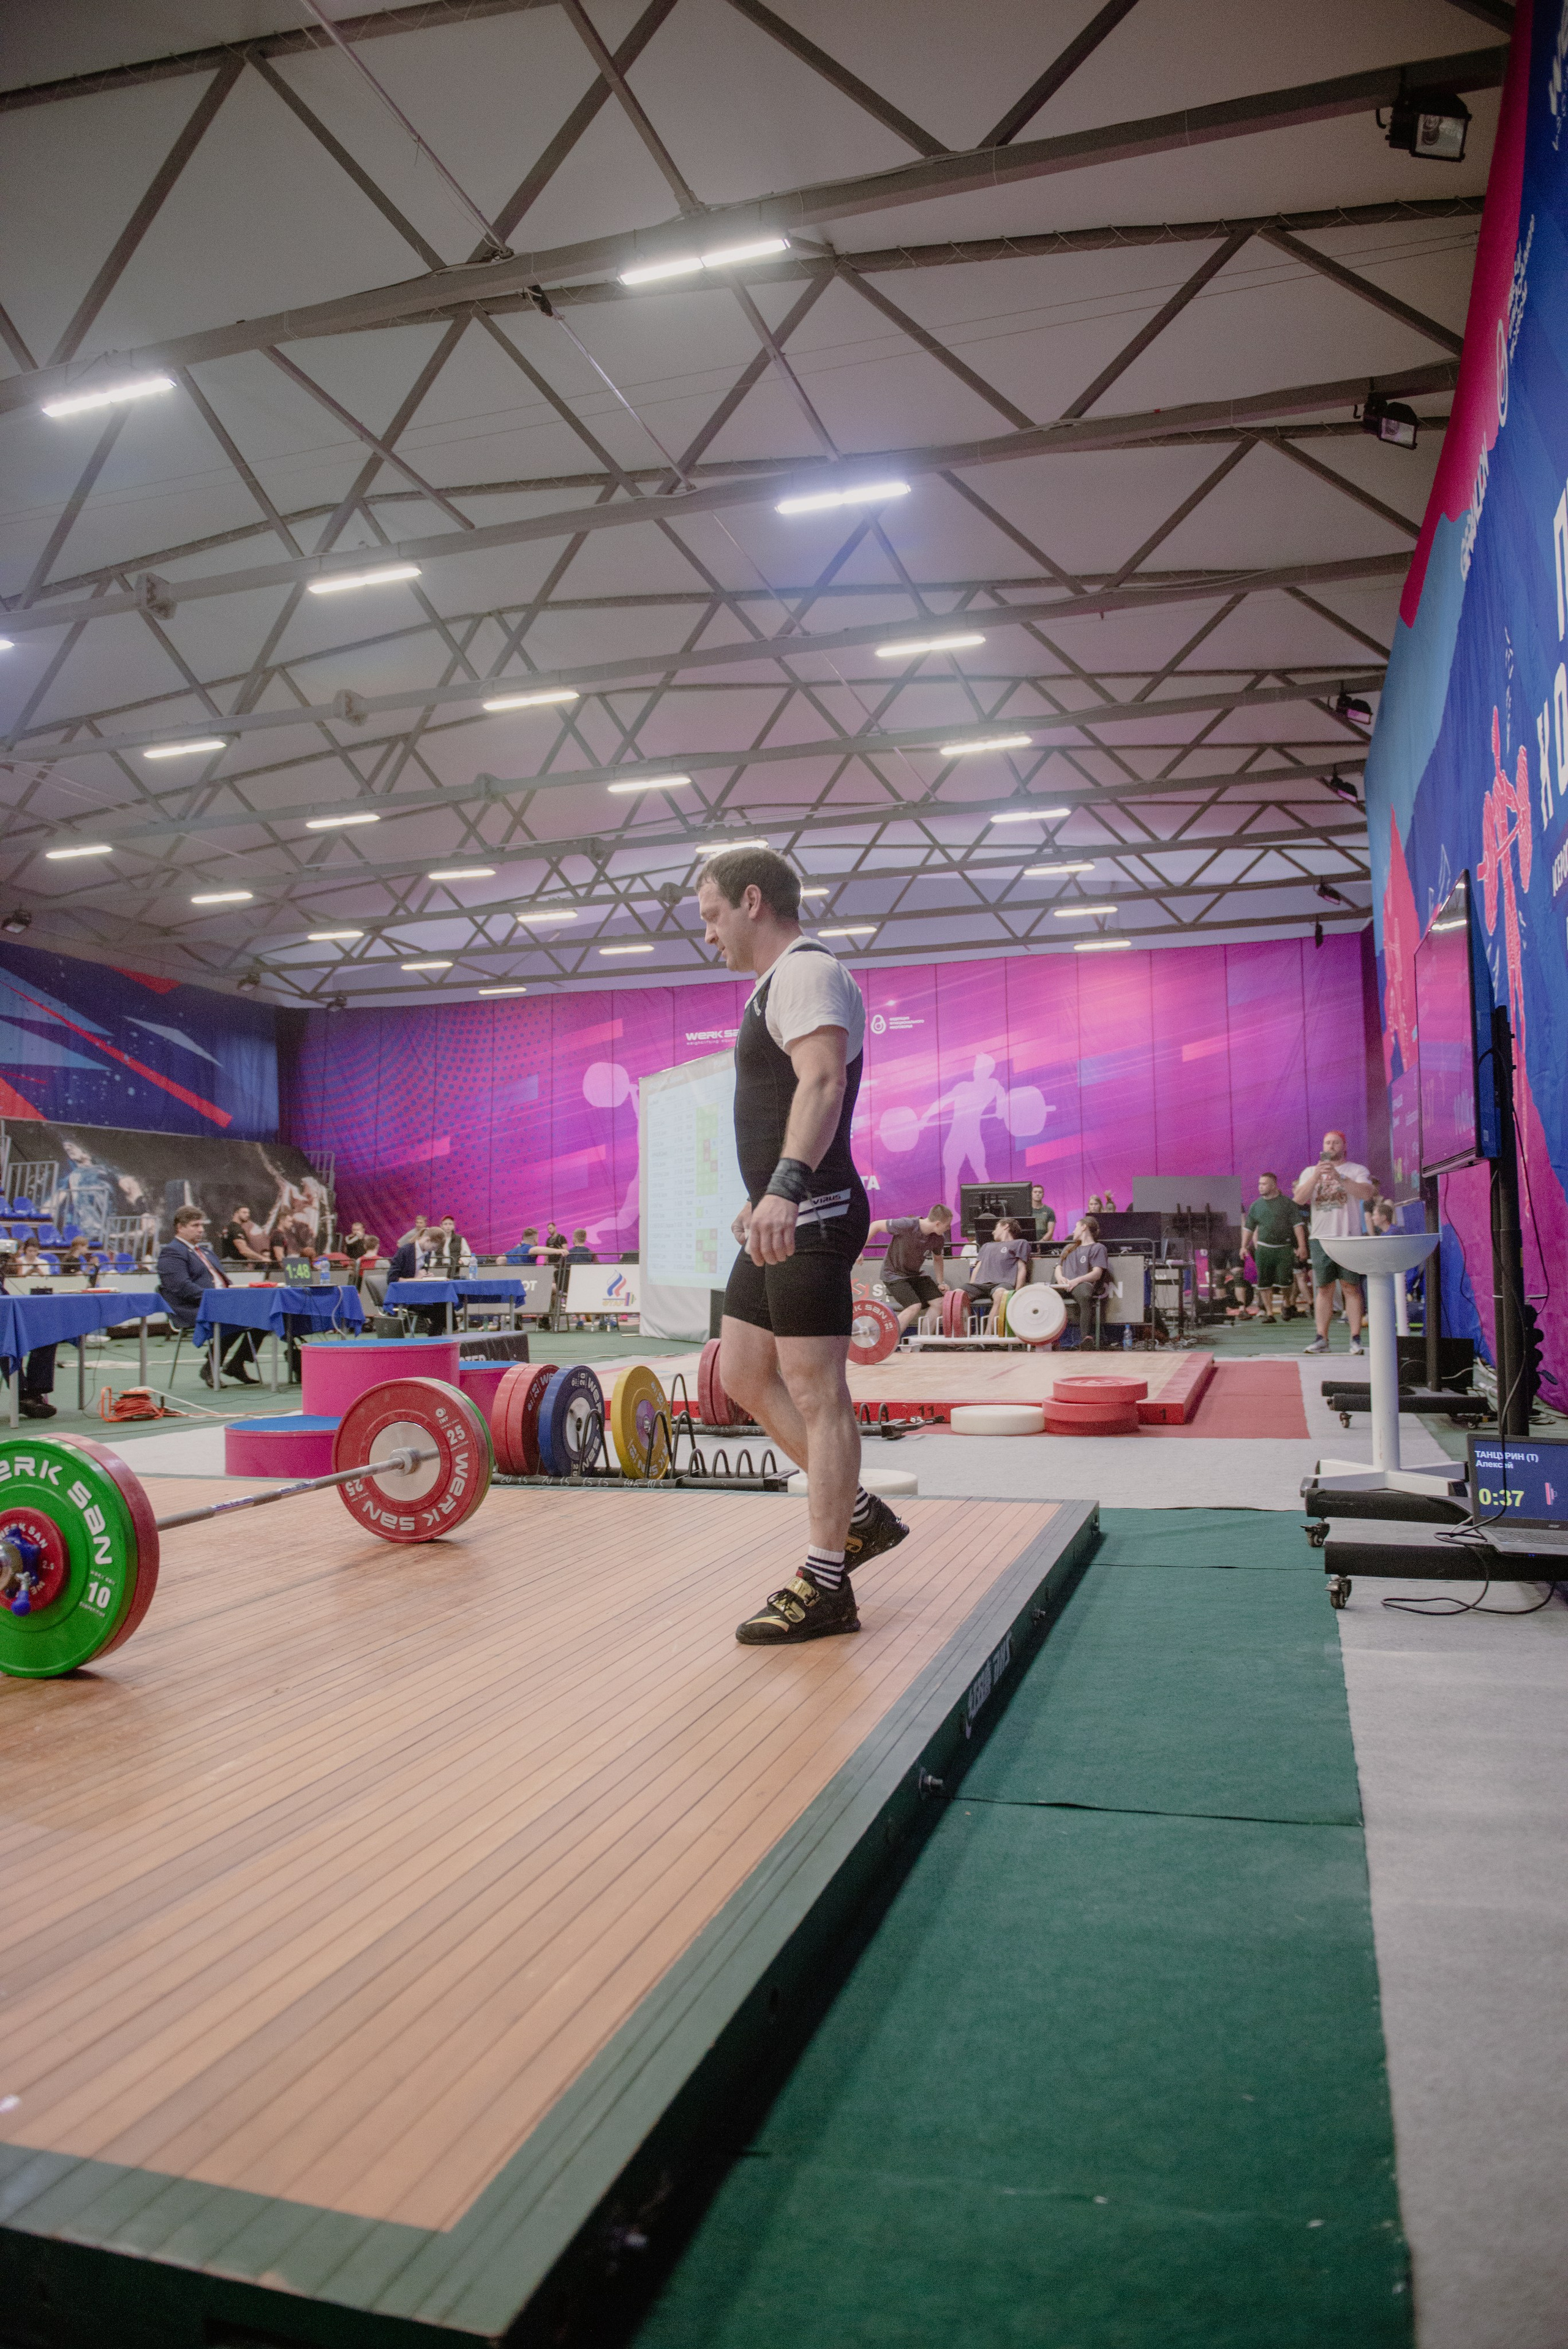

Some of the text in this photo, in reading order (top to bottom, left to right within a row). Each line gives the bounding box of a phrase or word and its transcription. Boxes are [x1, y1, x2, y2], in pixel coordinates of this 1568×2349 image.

[285, 1264, 311, 1279] 1:48
[447, 1425, 466, 1445] 25
[1478, 1488, 1525, 1507] 0:37
[88, 1582, 110, 1608] 10
